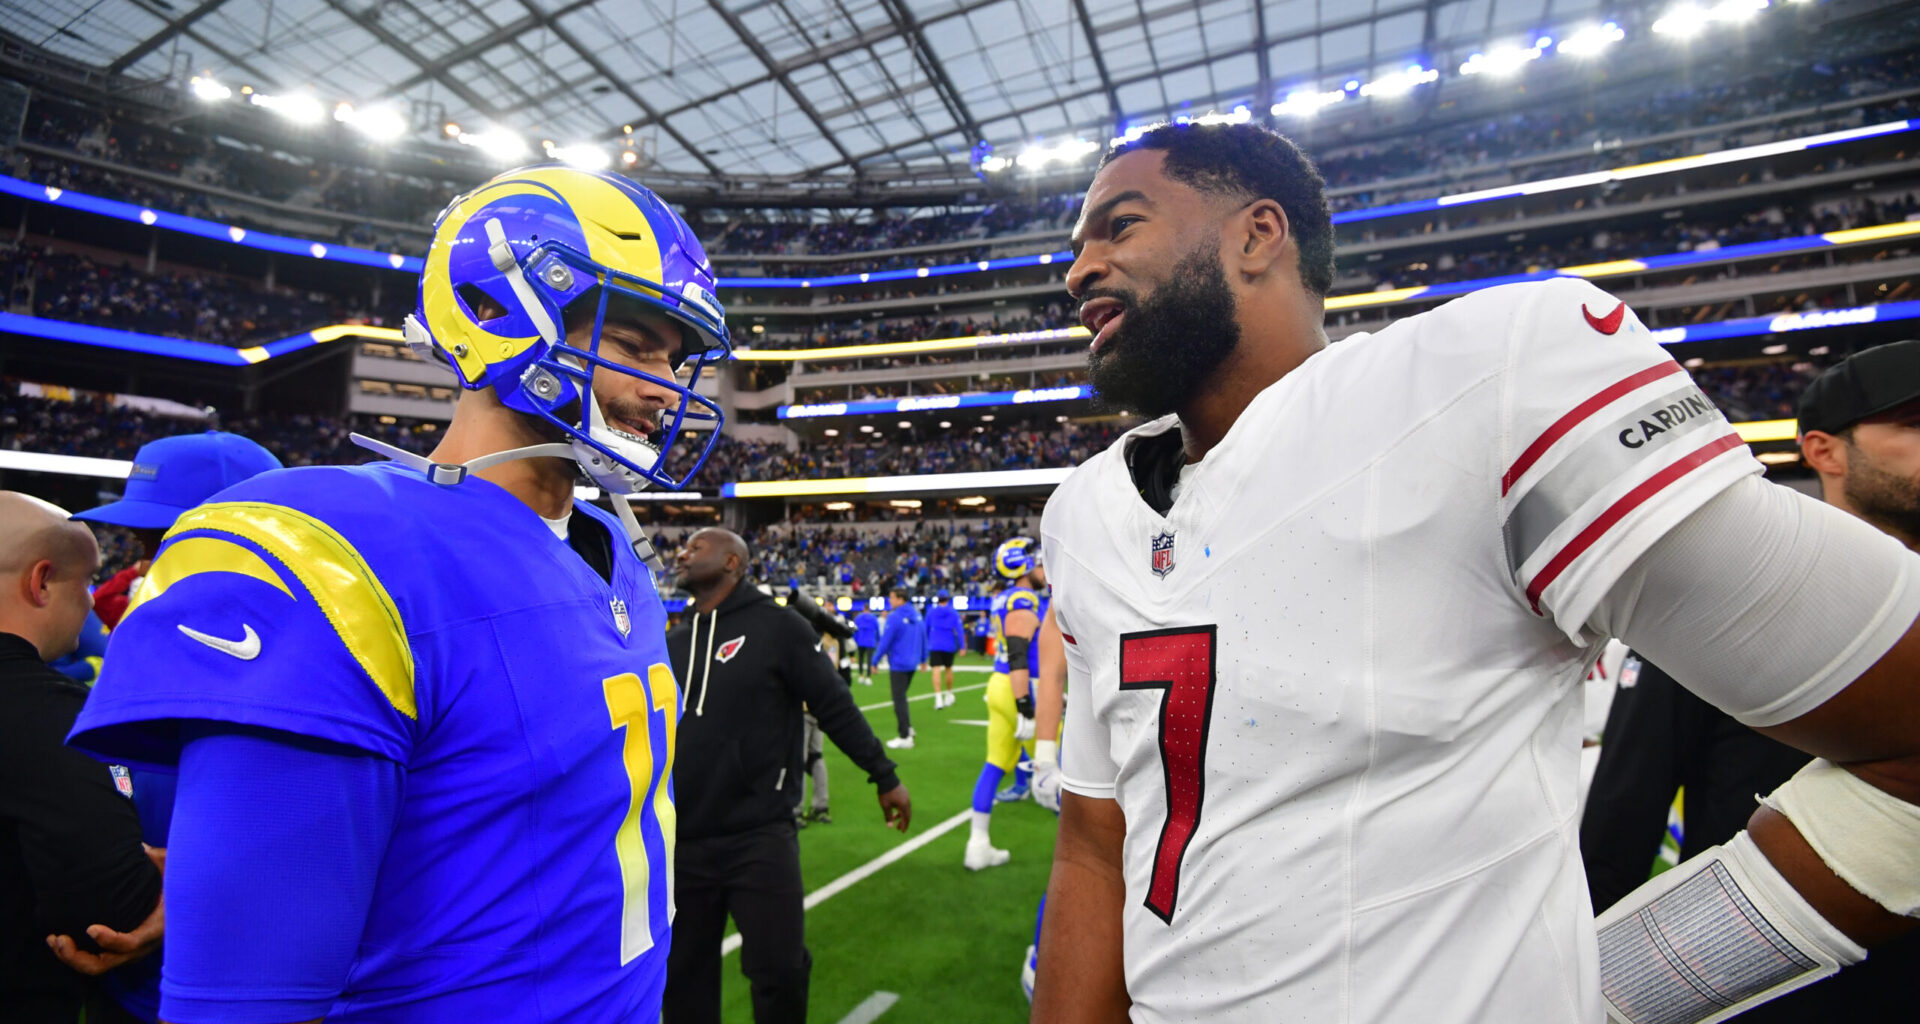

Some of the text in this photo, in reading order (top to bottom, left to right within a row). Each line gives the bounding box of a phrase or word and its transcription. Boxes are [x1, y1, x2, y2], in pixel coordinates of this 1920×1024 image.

[1619, 394, 1715, 449] CARDIN
[1154, 550, 1172, 570] NFL
[602, 663, 677, 967] 11
[1119, 624, 1217, 926] 7
